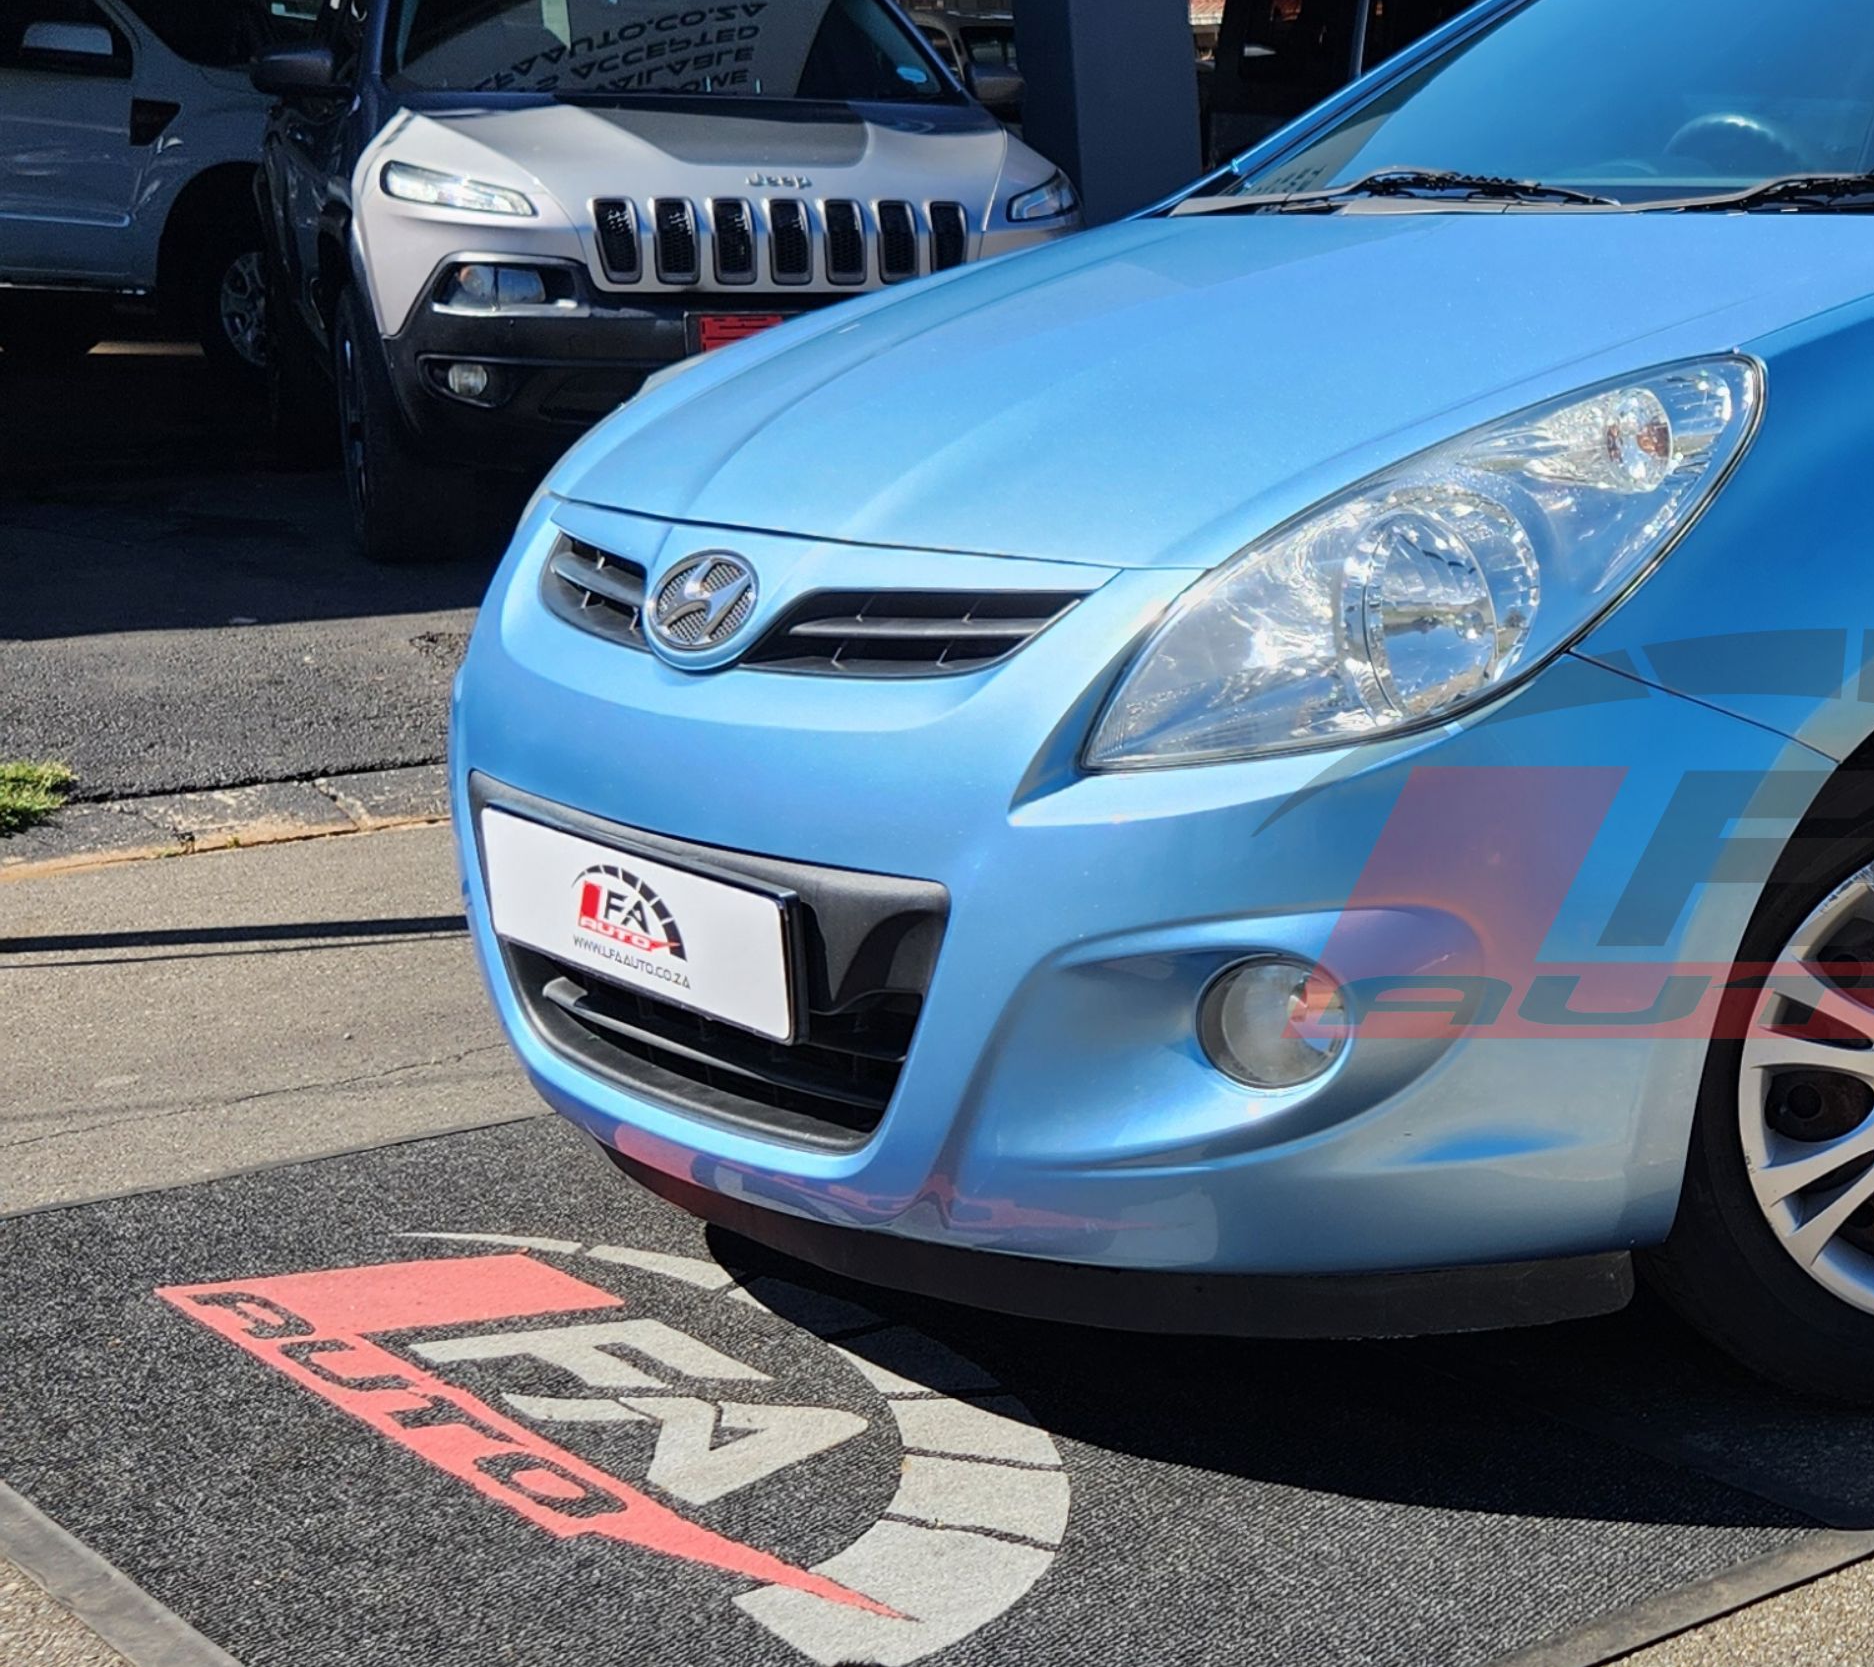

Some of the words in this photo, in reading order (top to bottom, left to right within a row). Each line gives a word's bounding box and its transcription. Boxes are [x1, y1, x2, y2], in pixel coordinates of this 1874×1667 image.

[744, 172, 813, 190] Jeep
[580, 916, 651, 950] AUTO
[573, 934, 691, 990] WWW.LFAAUTO.CO.ZA
[186, 1291, 629, 1520] AUTO
